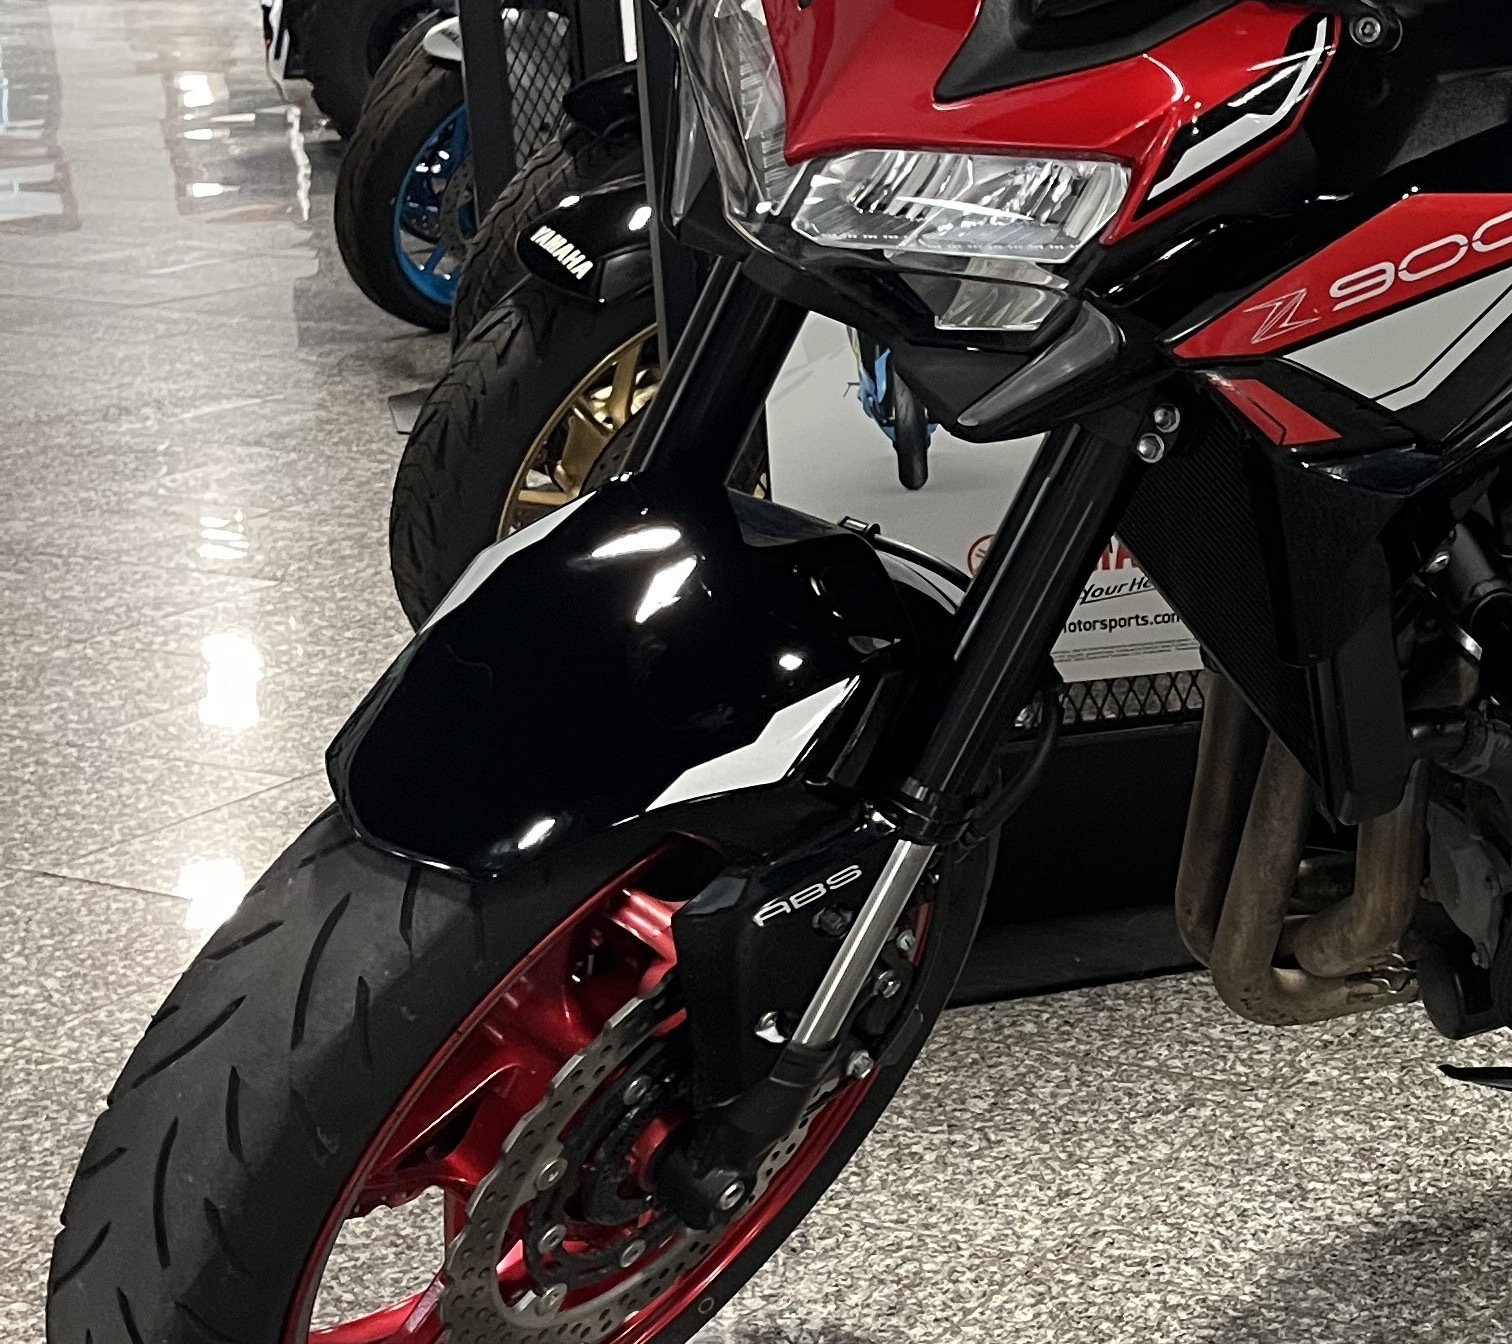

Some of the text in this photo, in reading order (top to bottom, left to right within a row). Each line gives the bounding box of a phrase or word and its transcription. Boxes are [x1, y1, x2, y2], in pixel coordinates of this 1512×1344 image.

[529, 224, 594, 281] YAMAHA
[1079, 582, 1129, 606] Your
[753, 864, 862, 927] ABS
